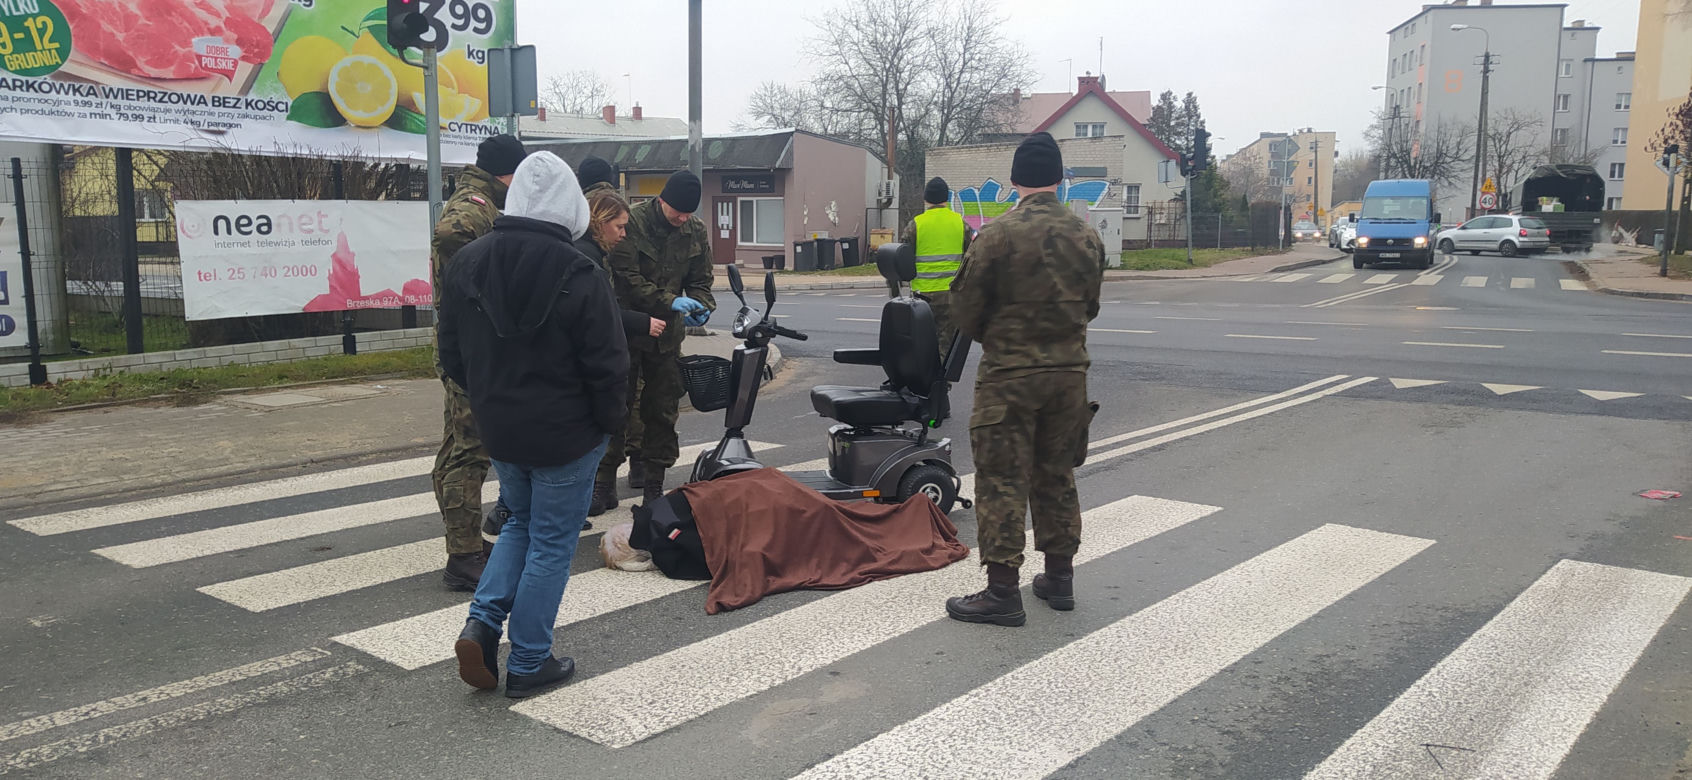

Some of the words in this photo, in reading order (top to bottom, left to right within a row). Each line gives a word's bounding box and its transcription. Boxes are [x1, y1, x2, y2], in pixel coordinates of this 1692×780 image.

[206, 44, 230, 57] DOBRE
[467, 44, 486, 64] kg
[4, 48, 62, 71] GRUDNIA
[201, 56, 235, 71] POLSKIE
[102, 86, 209, 107] WIEPRZOWA
[211, 95, 242, 109] BEZ
[245, 97, 289, 113] KOŚCI
[12, 95, 72, 107] promocyjna
[94, 101, 104, 109] zł
[110, 102, 121, 111] kg
[123, 104, 173, 114] obowiązuje
[174, 106, 216, 118] wyłącznie
[218, 110, 236, 119] przy
[236, 112, 275, 121] zakupach
[20, 105, 75, 117] produktów
[89, 110, 114, 120] min.
[115, 112, 145, 122] 79,99
[146, 114, 157, 123] zł
[190, 119, 201, 128] kg
[207, 121, 242, 130] paragon
[448, 121, 500, 136] CYTRYNA
[1481, 196, 1494, 205] 40
[214, 240, 251, 249] internet
[256, 238, 296, 249] telewizja
[300, 237, 333, 248] telefon
[197, 268, 222, 282] tel.
[227, 267, 246, 281] 25
[282, 264, 318, 278] 2000
[346, 298, 381, 308] Brzeska
